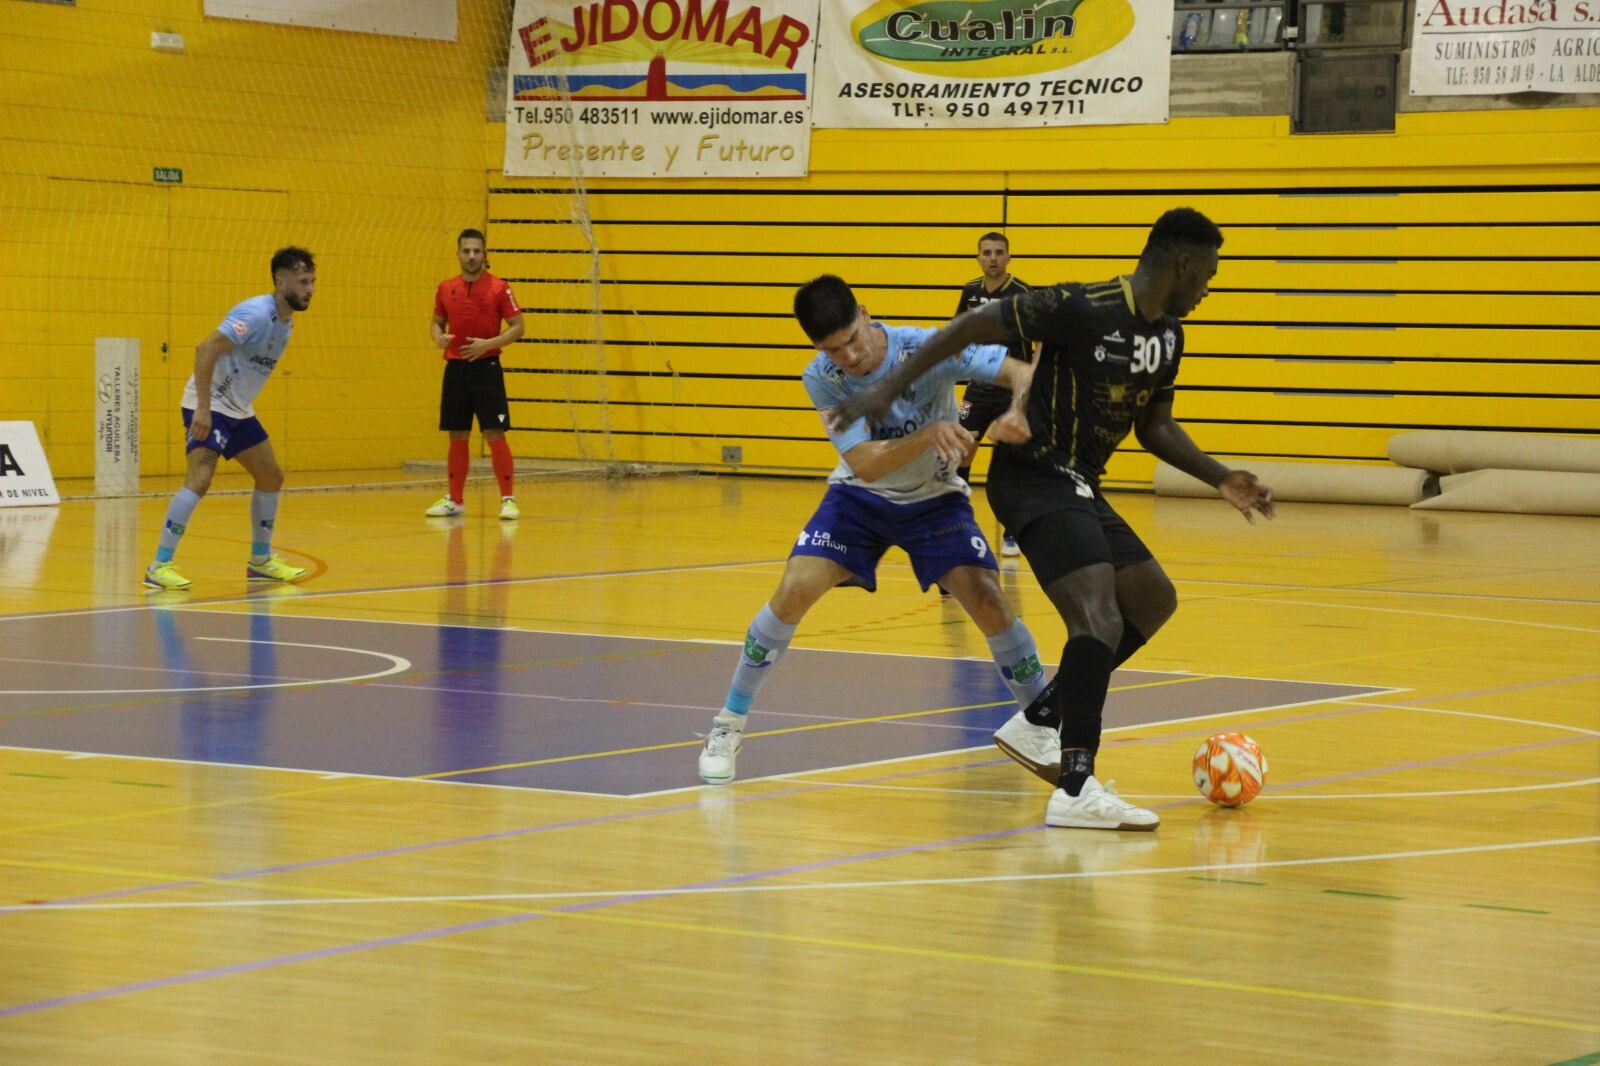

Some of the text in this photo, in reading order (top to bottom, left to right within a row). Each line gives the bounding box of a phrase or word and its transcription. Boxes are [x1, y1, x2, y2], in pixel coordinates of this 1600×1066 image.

[1423, 0, 1557, 26] Audasa
[518, 0, 810, 70] EJIDOMAR
[885, 8, 1076, 43] Cualin
[940, 45, 1046, 57] INTEGRAL
[1434, 38, 1536, 60] SUMINISTROS
[1446, 67, 1469, 86] TLF:
[1473, 66, 1491, 85] 950
[1550, 64, 1564, 82] LA
[839, 76, 1143, 99] ASESORAMIENTO TECNICO
[579, 108, 639, 124] 483511
[651, 108, 804, 129] www.ejidomar.es
[892, 100, 1085, 117] TLF: 950 497711
[521, 133, 794, 171] Presente y Futuro
[1130, 335, 1161, 374] 30
[6, 489, 19, 498] DE
[21, 488, 48, 497] NIVEL
[971, 536, 987, 558] 9
